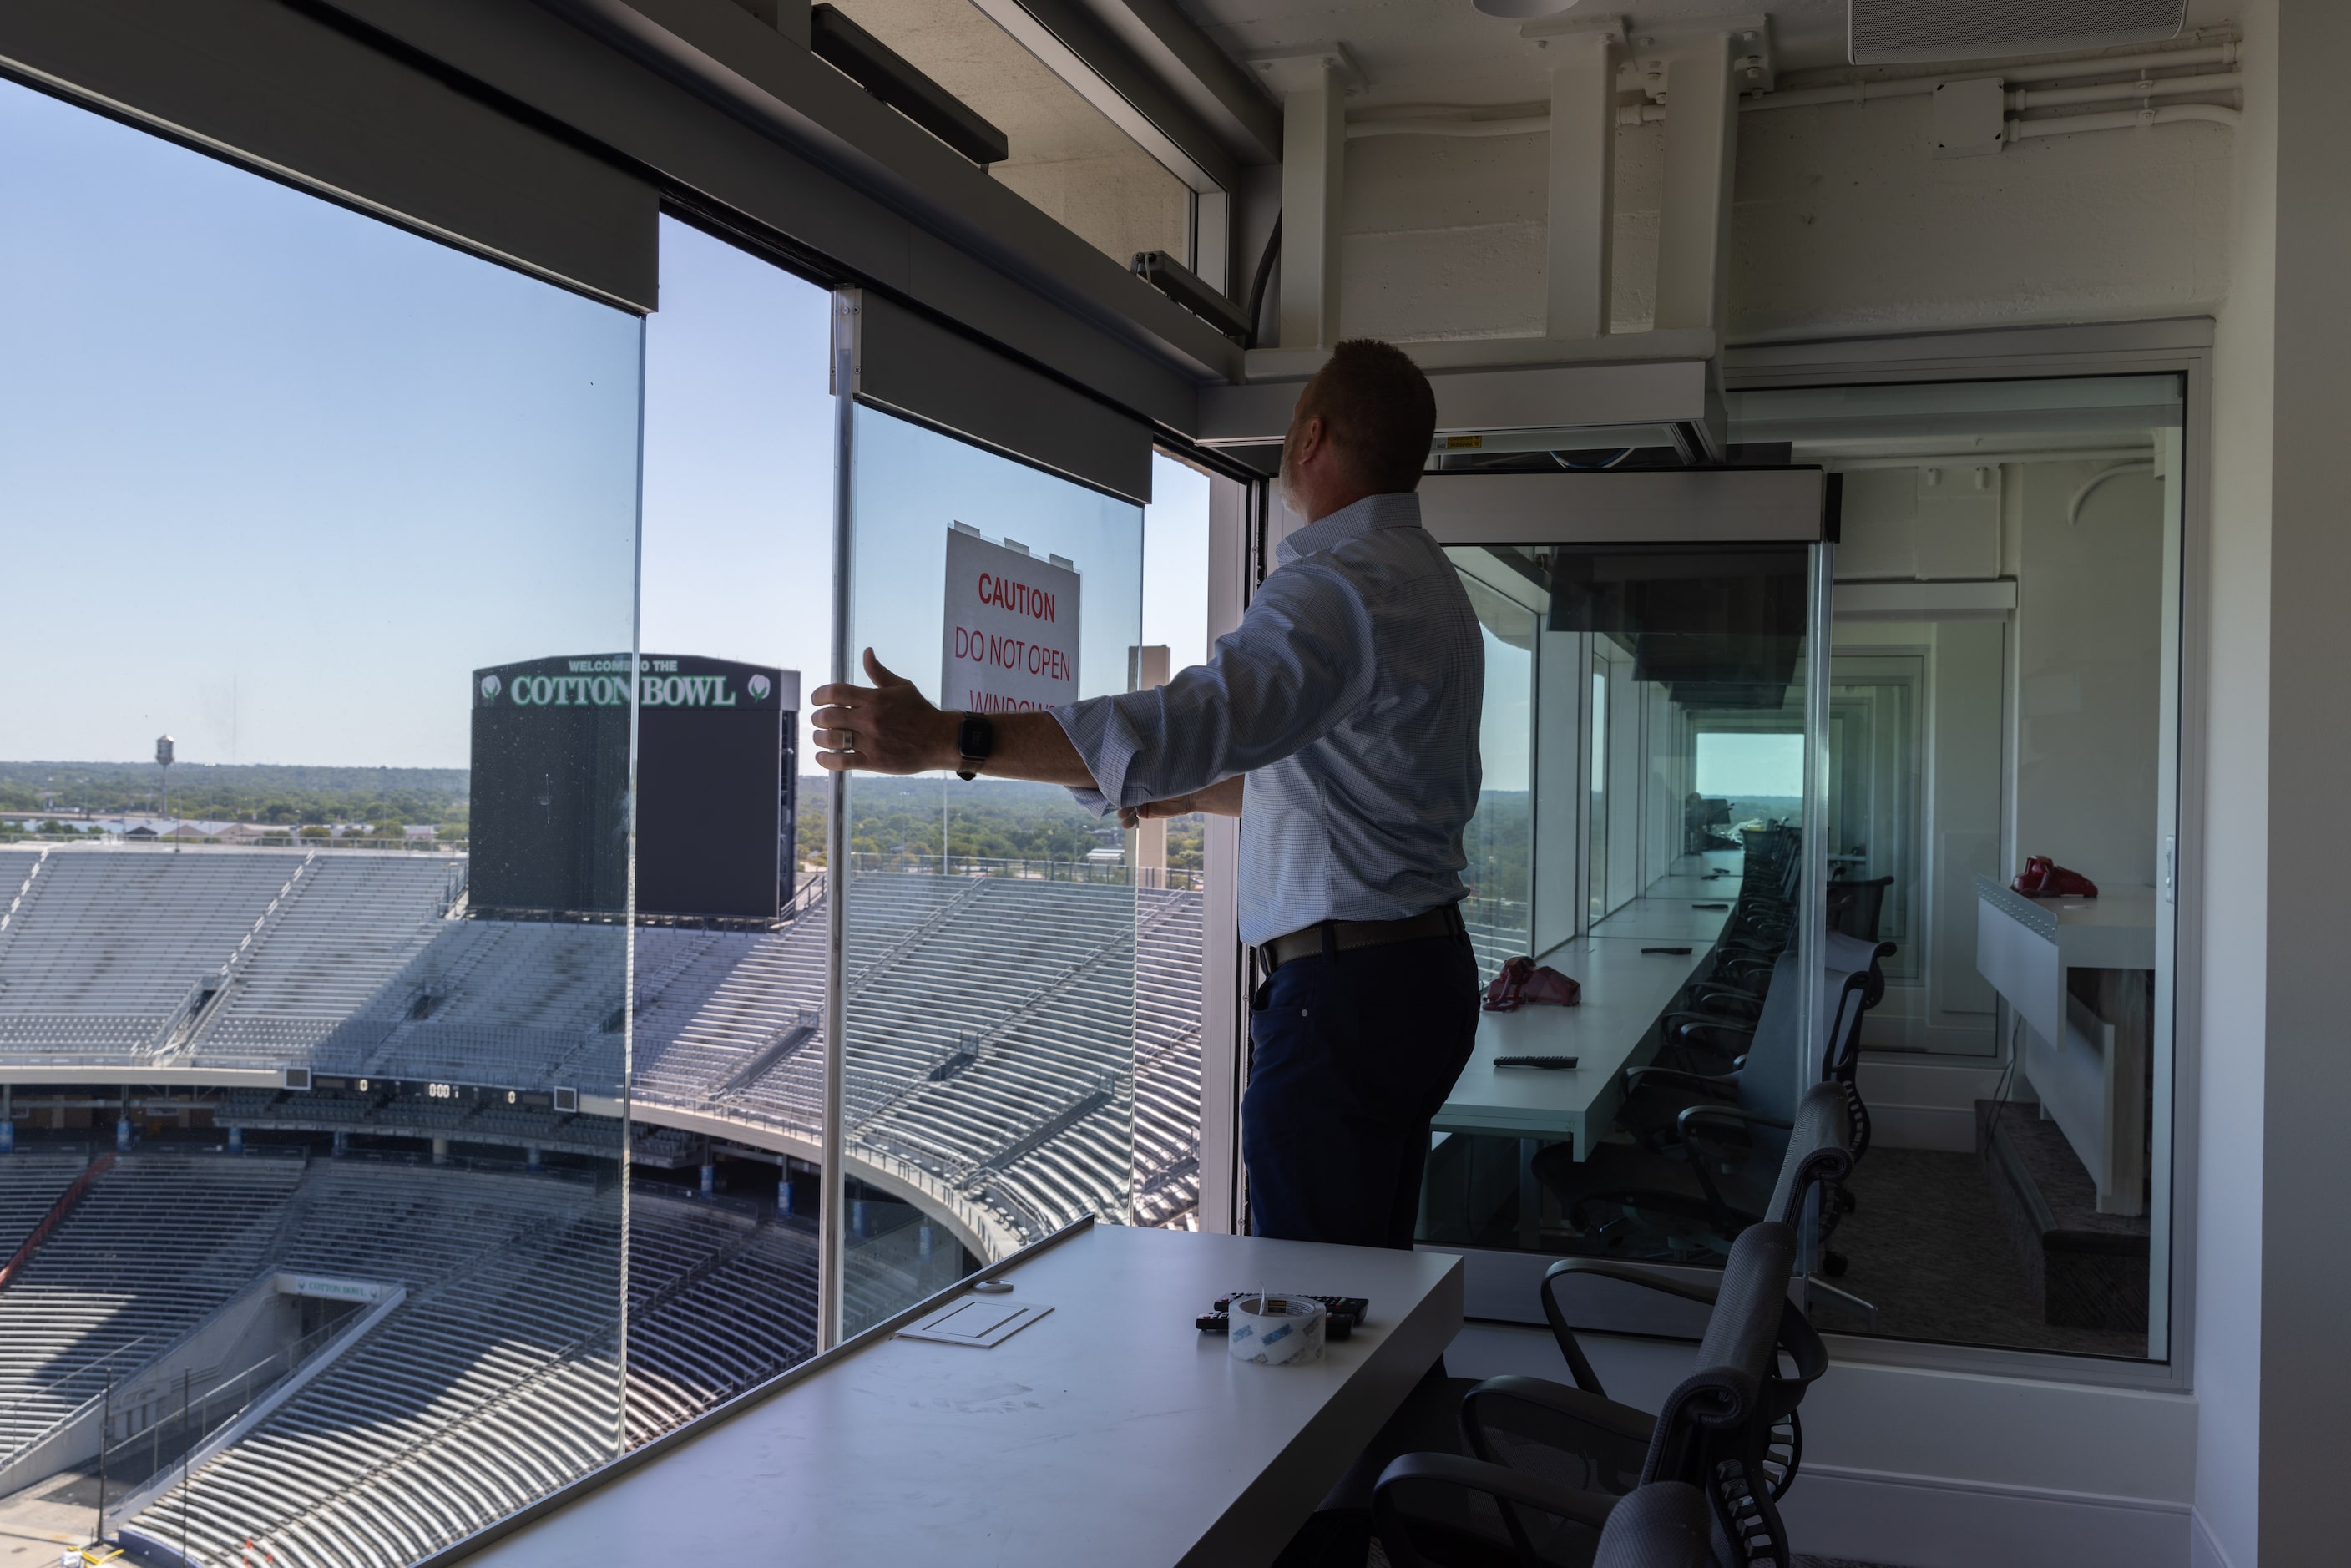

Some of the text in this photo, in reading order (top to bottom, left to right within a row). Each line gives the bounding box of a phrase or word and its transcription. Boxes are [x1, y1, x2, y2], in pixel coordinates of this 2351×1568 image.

[978, 572, 1055, 623] CAUTION
[569, 660, 632, 672] WELCOME
[652, 660, 678, 672] THE
[955, 626, 1070, 682] DO NOT OPEN
[510, 675, 736, 706] COTTON BOWL
